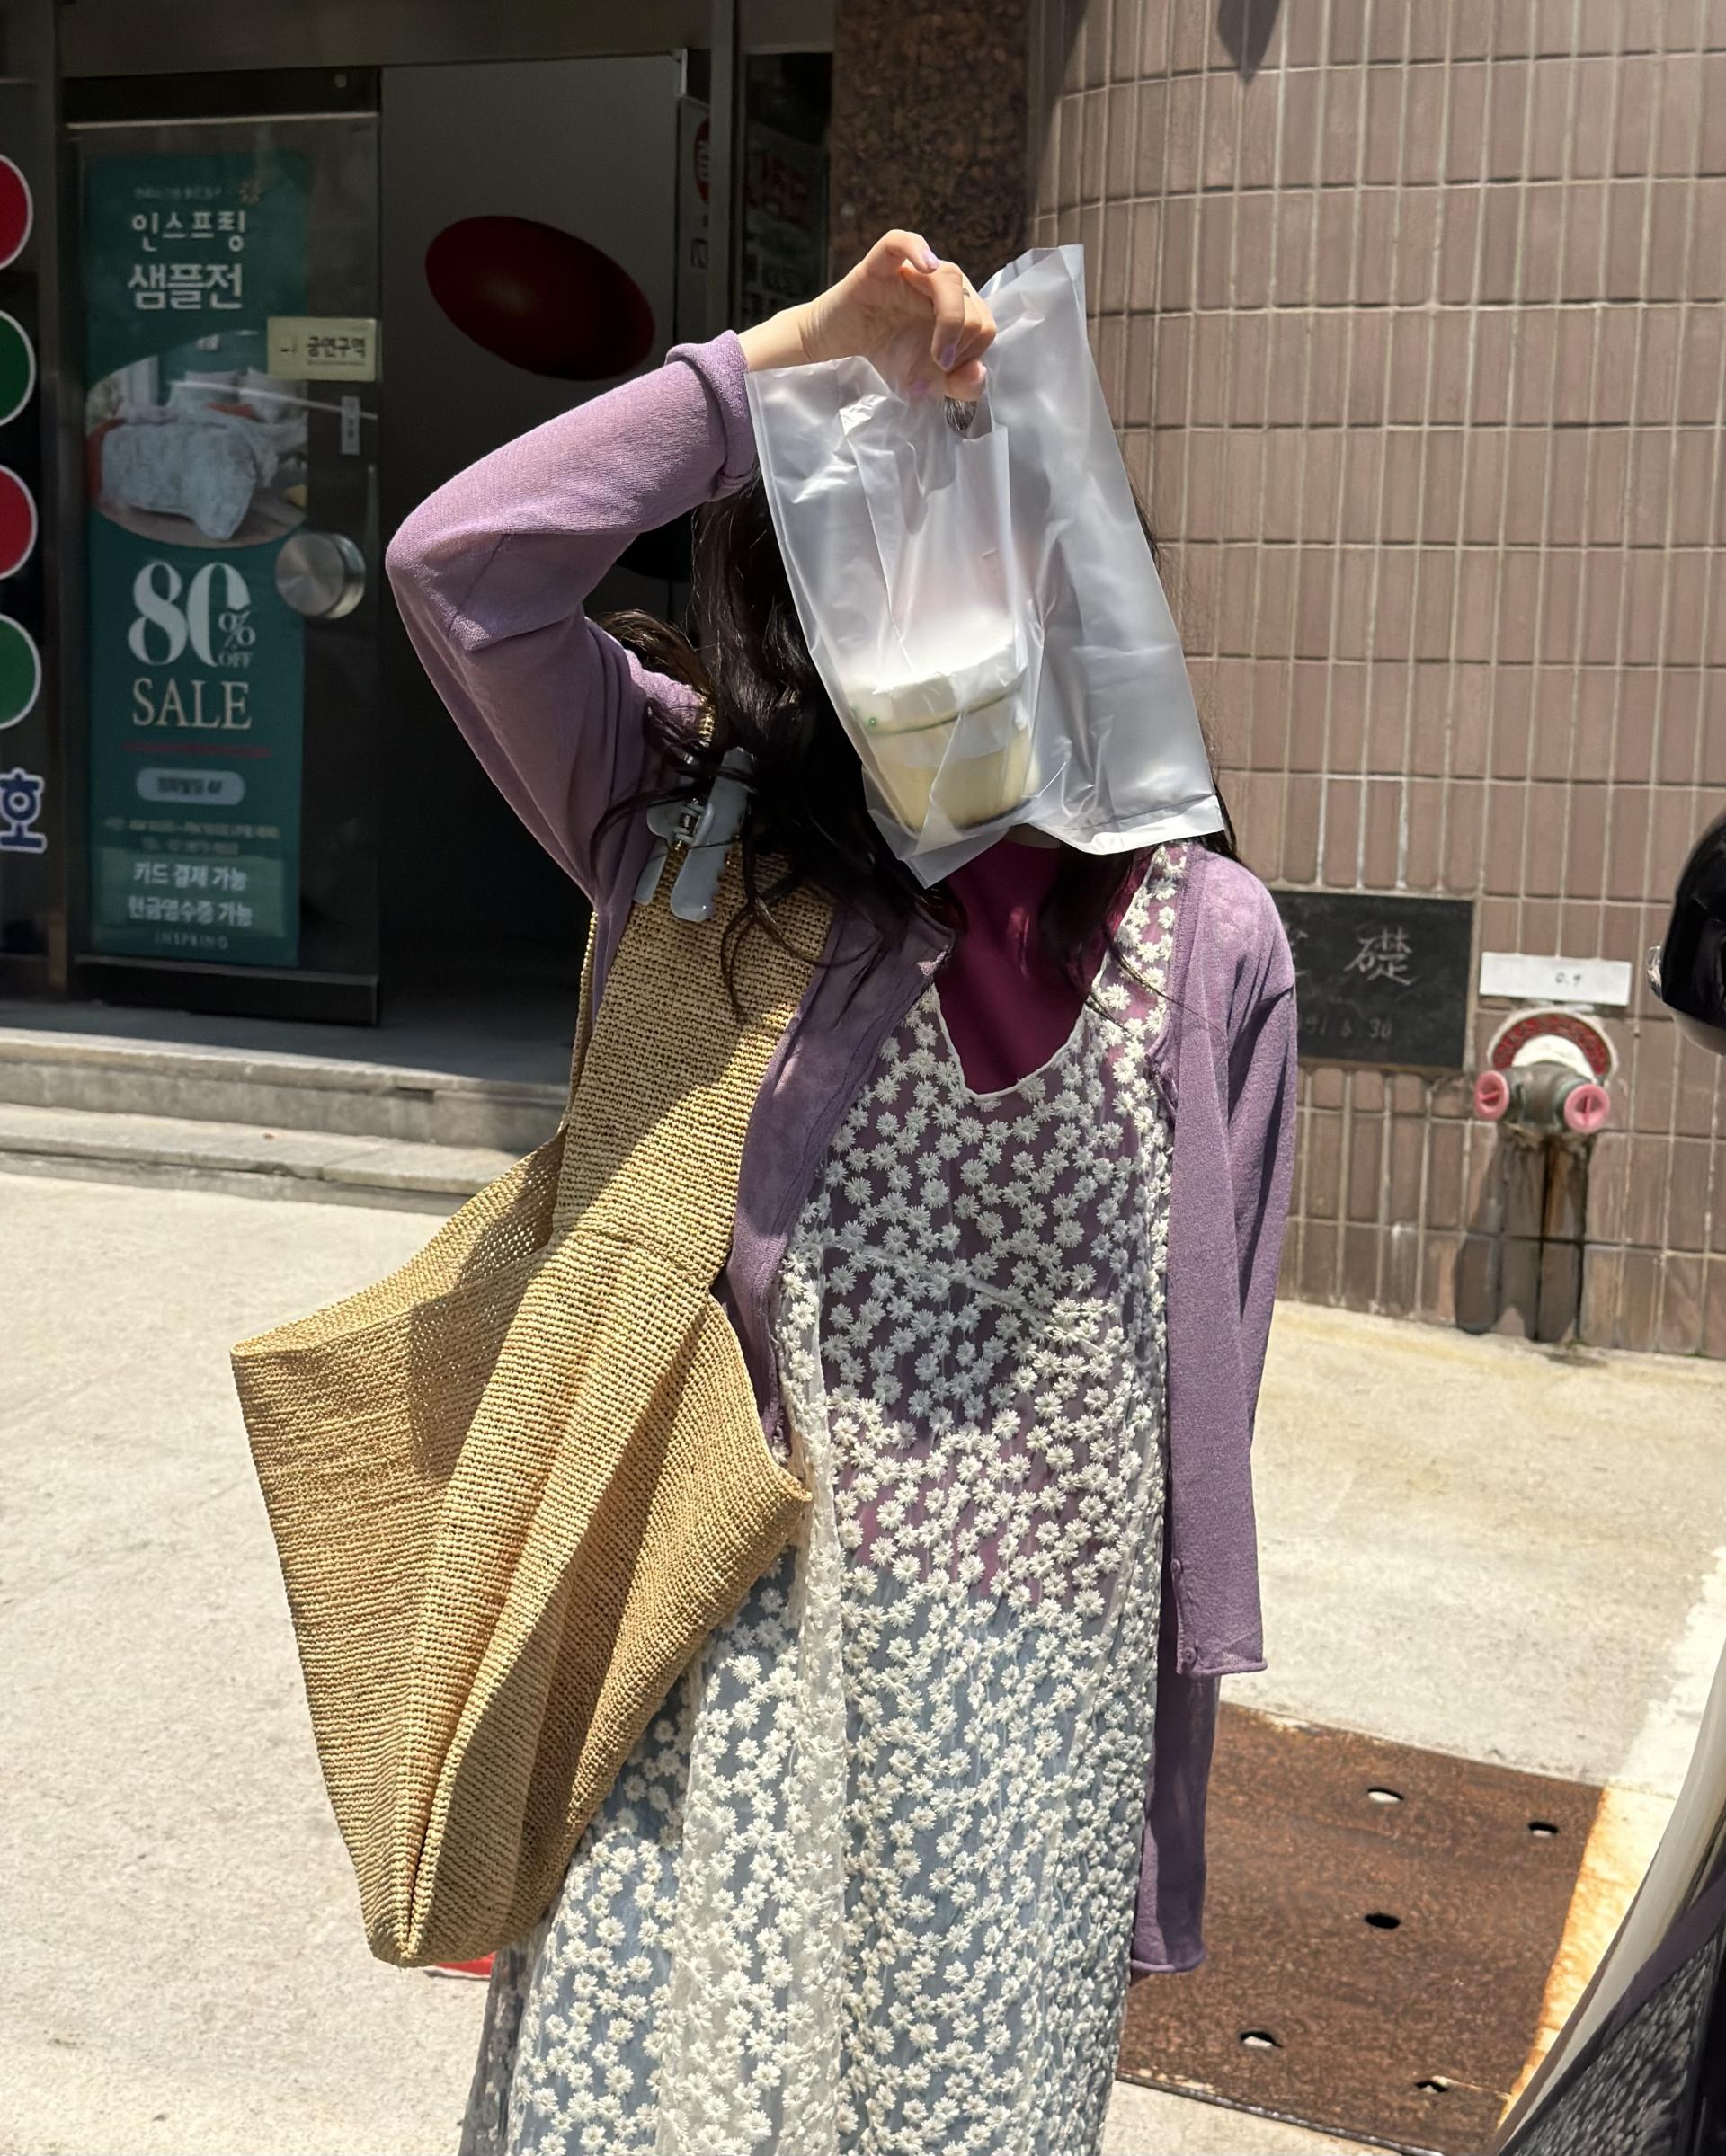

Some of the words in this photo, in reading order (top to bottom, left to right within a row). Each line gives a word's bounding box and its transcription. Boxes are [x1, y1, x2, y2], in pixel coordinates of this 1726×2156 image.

[130, 209, 246, 253] 인스프링
[127, 262, 244, 310] 샘플전
[217, 652, 254, 669] OFF
[132, 677, 253, 730] SALE
[0, 767, 48, 855] 호
[133, 861, 170, 885] 카드
[211, 865, 248, 892] 가능
[217, 901, 254, 927] 가능
